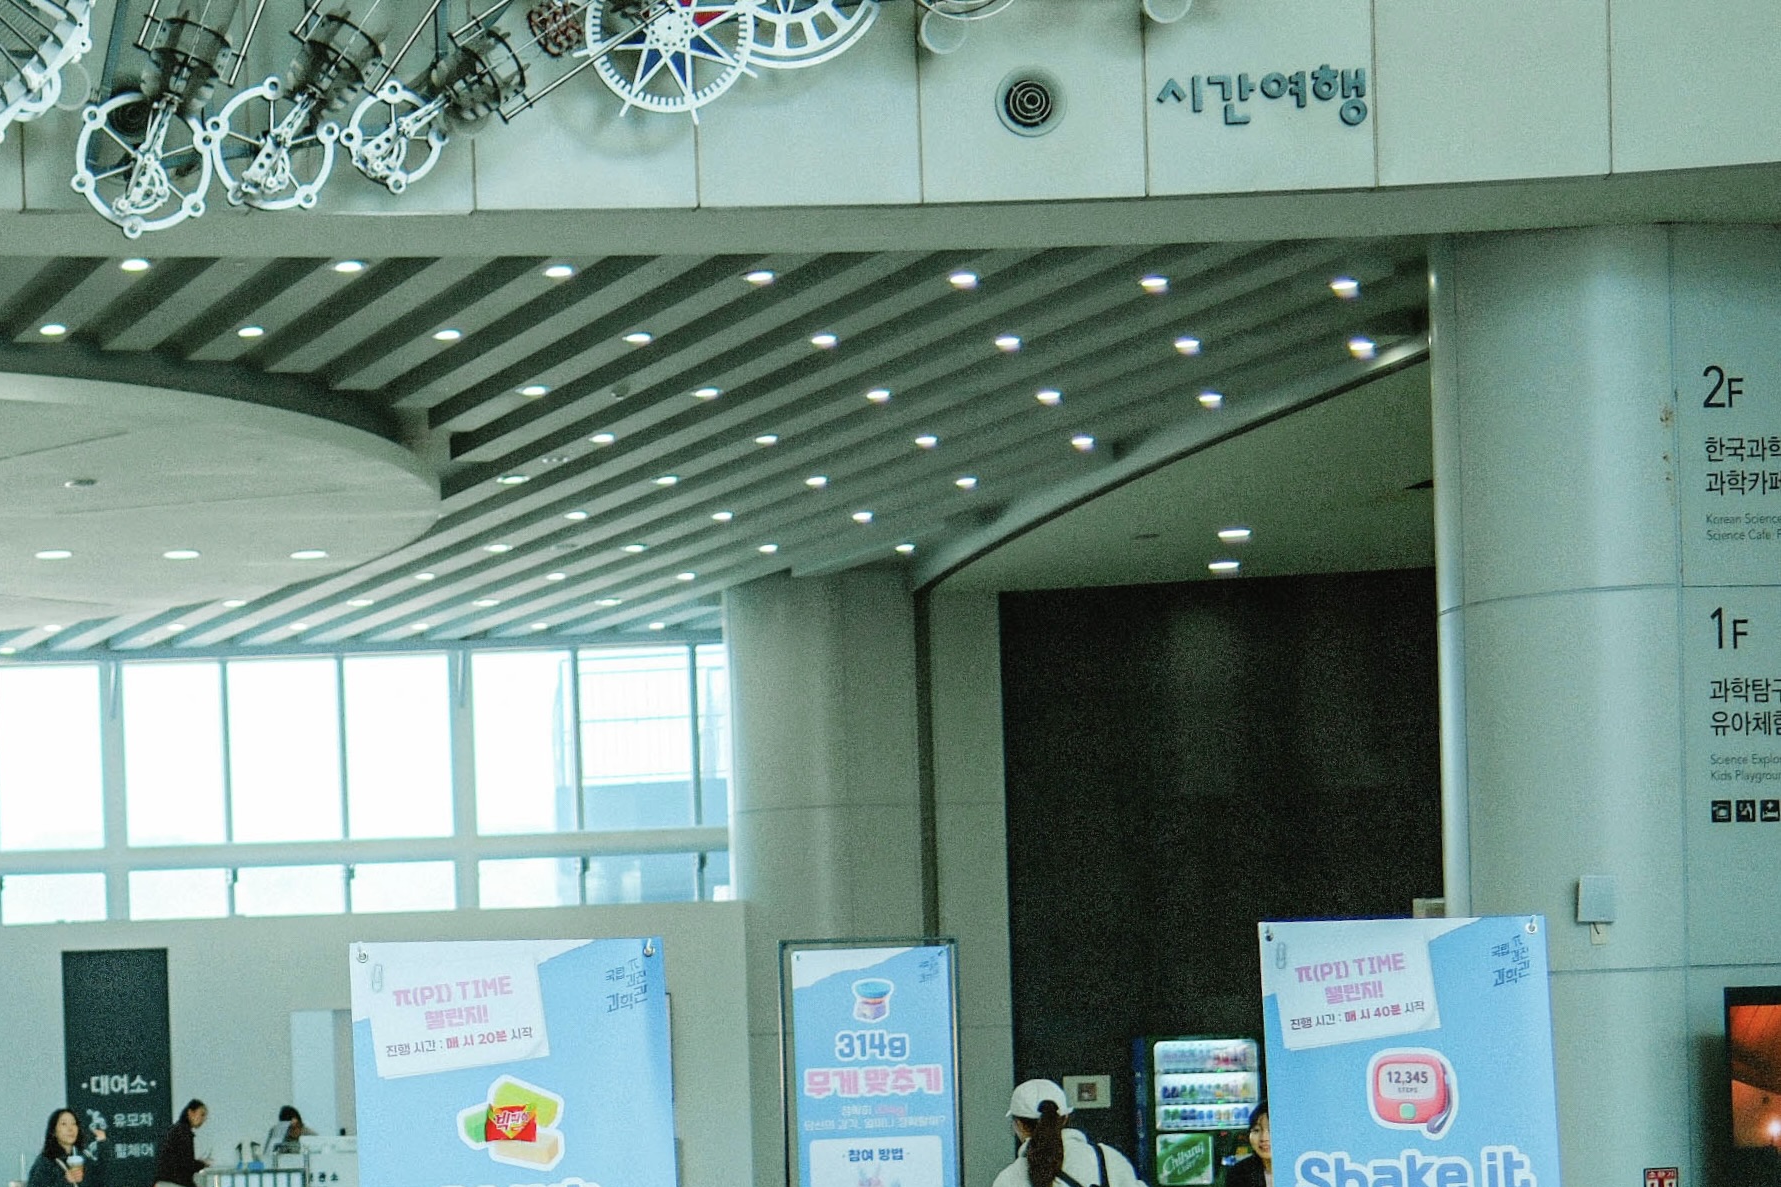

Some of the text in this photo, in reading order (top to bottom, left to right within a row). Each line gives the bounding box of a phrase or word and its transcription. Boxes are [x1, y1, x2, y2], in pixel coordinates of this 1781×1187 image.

[1157, 64, 1368, 125] 시간여행
[1703, 365, 1744, 408] 2F
[1706, 513, 1741, 524] Korean
[1707, 529, 1746, 541] Science
[1710, 607, 1748, 650] 1F
[1711, 754, 1748, 767] Science
[1711, 769, 1732, 781] Kids
[1353, 952, 1406, 976] TIME
[455, 975, 514, 1000] TIME
[1324, 980, 1384, 1005] 챌린지!
[424, 1004, 489, 1030] 챌린지!
[1290, 1000, 1425, 1030] 진행 시간 매 시 40분 시작
[385, 1026, 533, 1058] 진행 시간 매 시 20분 시작
[837, 1032, 907, 1058] 314g
[89, 1074, 149, 1096] 대여소
[806, 1066, 942, 1096] 무게 맞추기
[1386, 1070, 1428, 1086] 12,345
[113, 1113, 153, 1128] 유모차
[848, 1147, 904, 1162] 참여 방법
